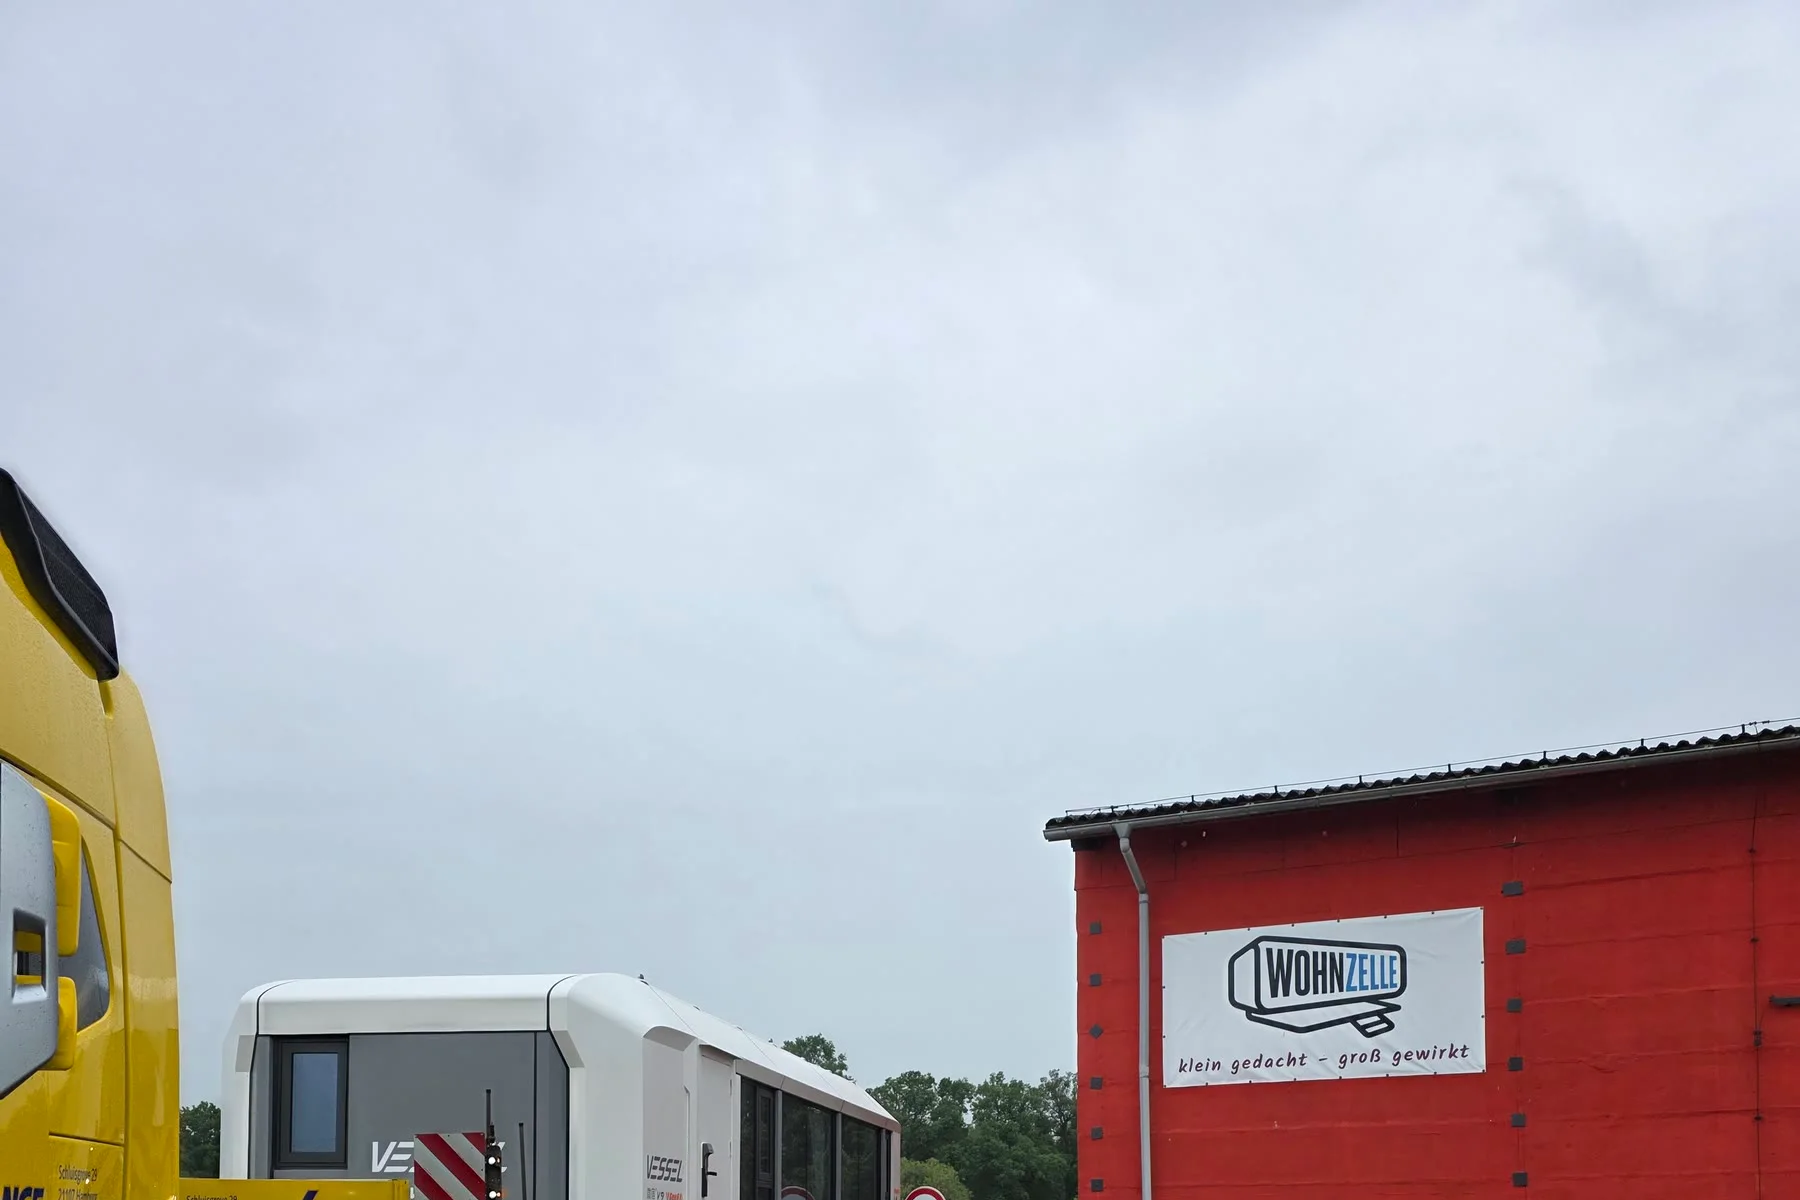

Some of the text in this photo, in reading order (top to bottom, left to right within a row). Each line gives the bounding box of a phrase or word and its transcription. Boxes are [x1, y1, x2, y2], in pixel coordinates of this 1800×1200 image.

[1266, 948, 1397, 998] WOHNZELLE
[1178, 1058, 1222, 1073] klein
[1231, 1053, 1308, 1074] gedacht
[1338, 1049, 1381, 1069] groß
[1392, 1043, 1470, 1062] gewirkt
[91, 1168, 98, 1182] 29
[647, 1155, 683, 1182] VESSEL
